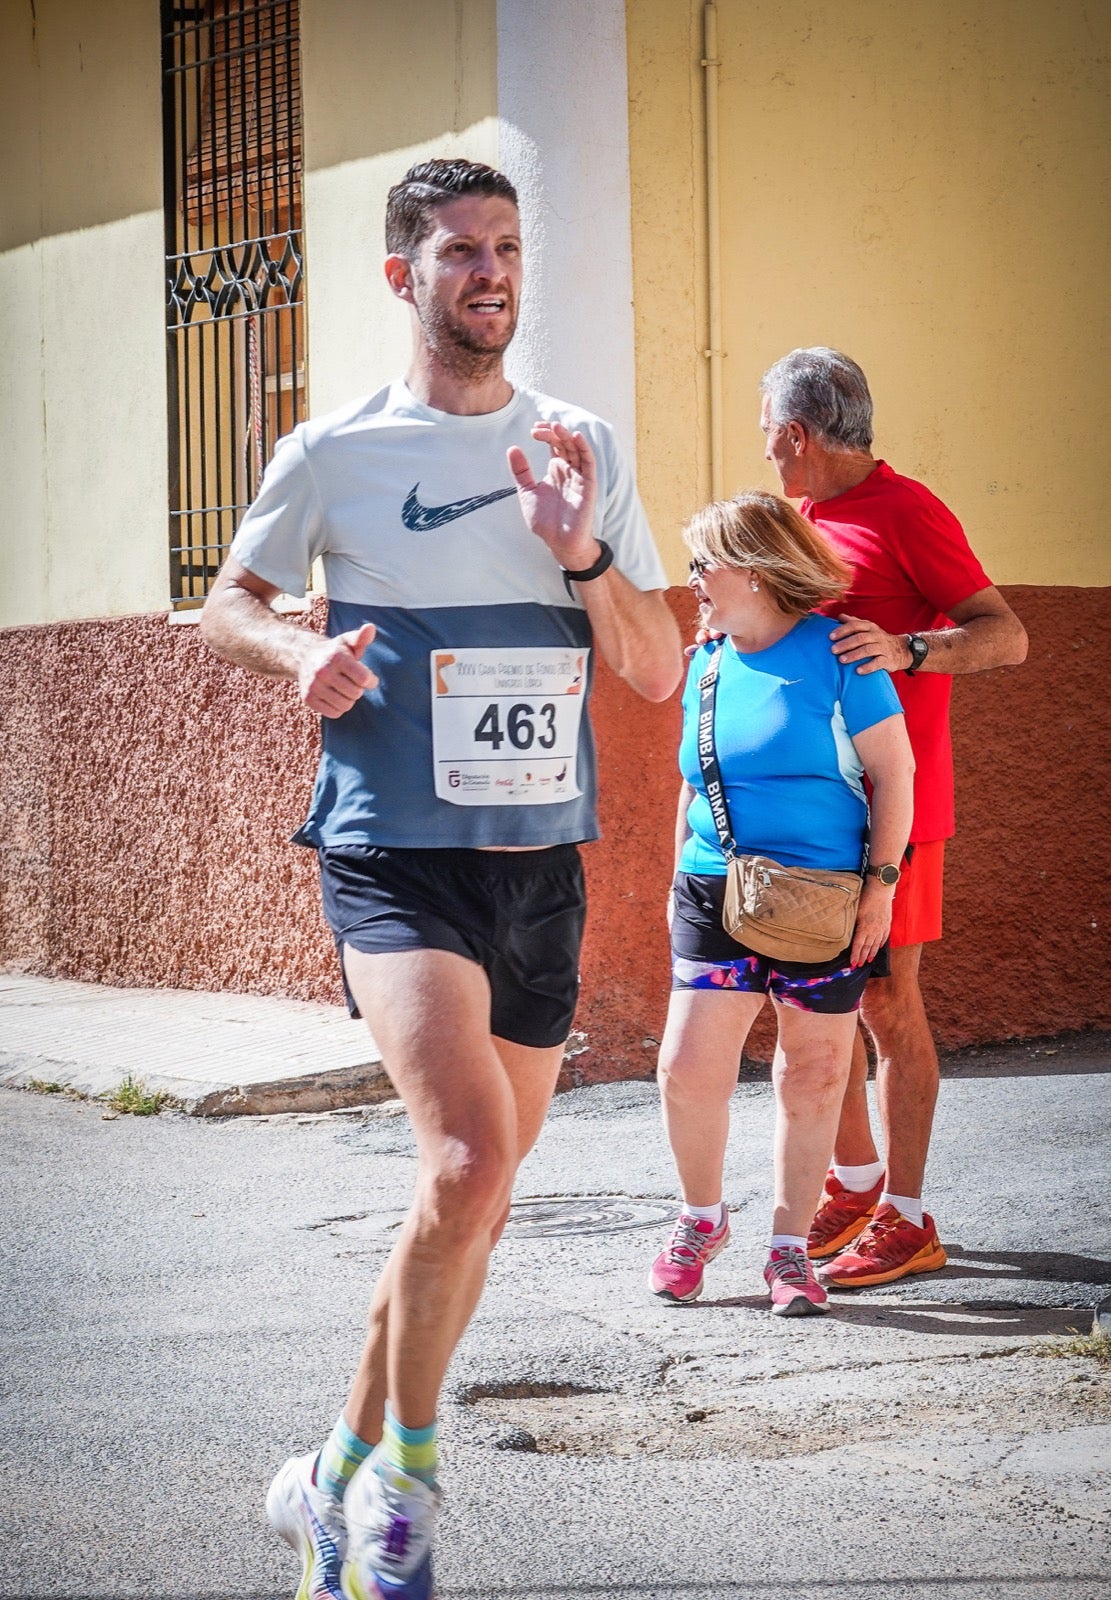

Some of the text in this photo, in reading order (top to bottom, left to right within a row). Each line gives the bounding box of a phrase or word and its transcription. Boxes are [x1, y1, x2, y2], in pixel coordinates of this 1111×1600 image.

[474, 703, 556, 750] 463
[699, 709, 715, 770] BIMBA
[707, 780, 730, 844] BIMBA
